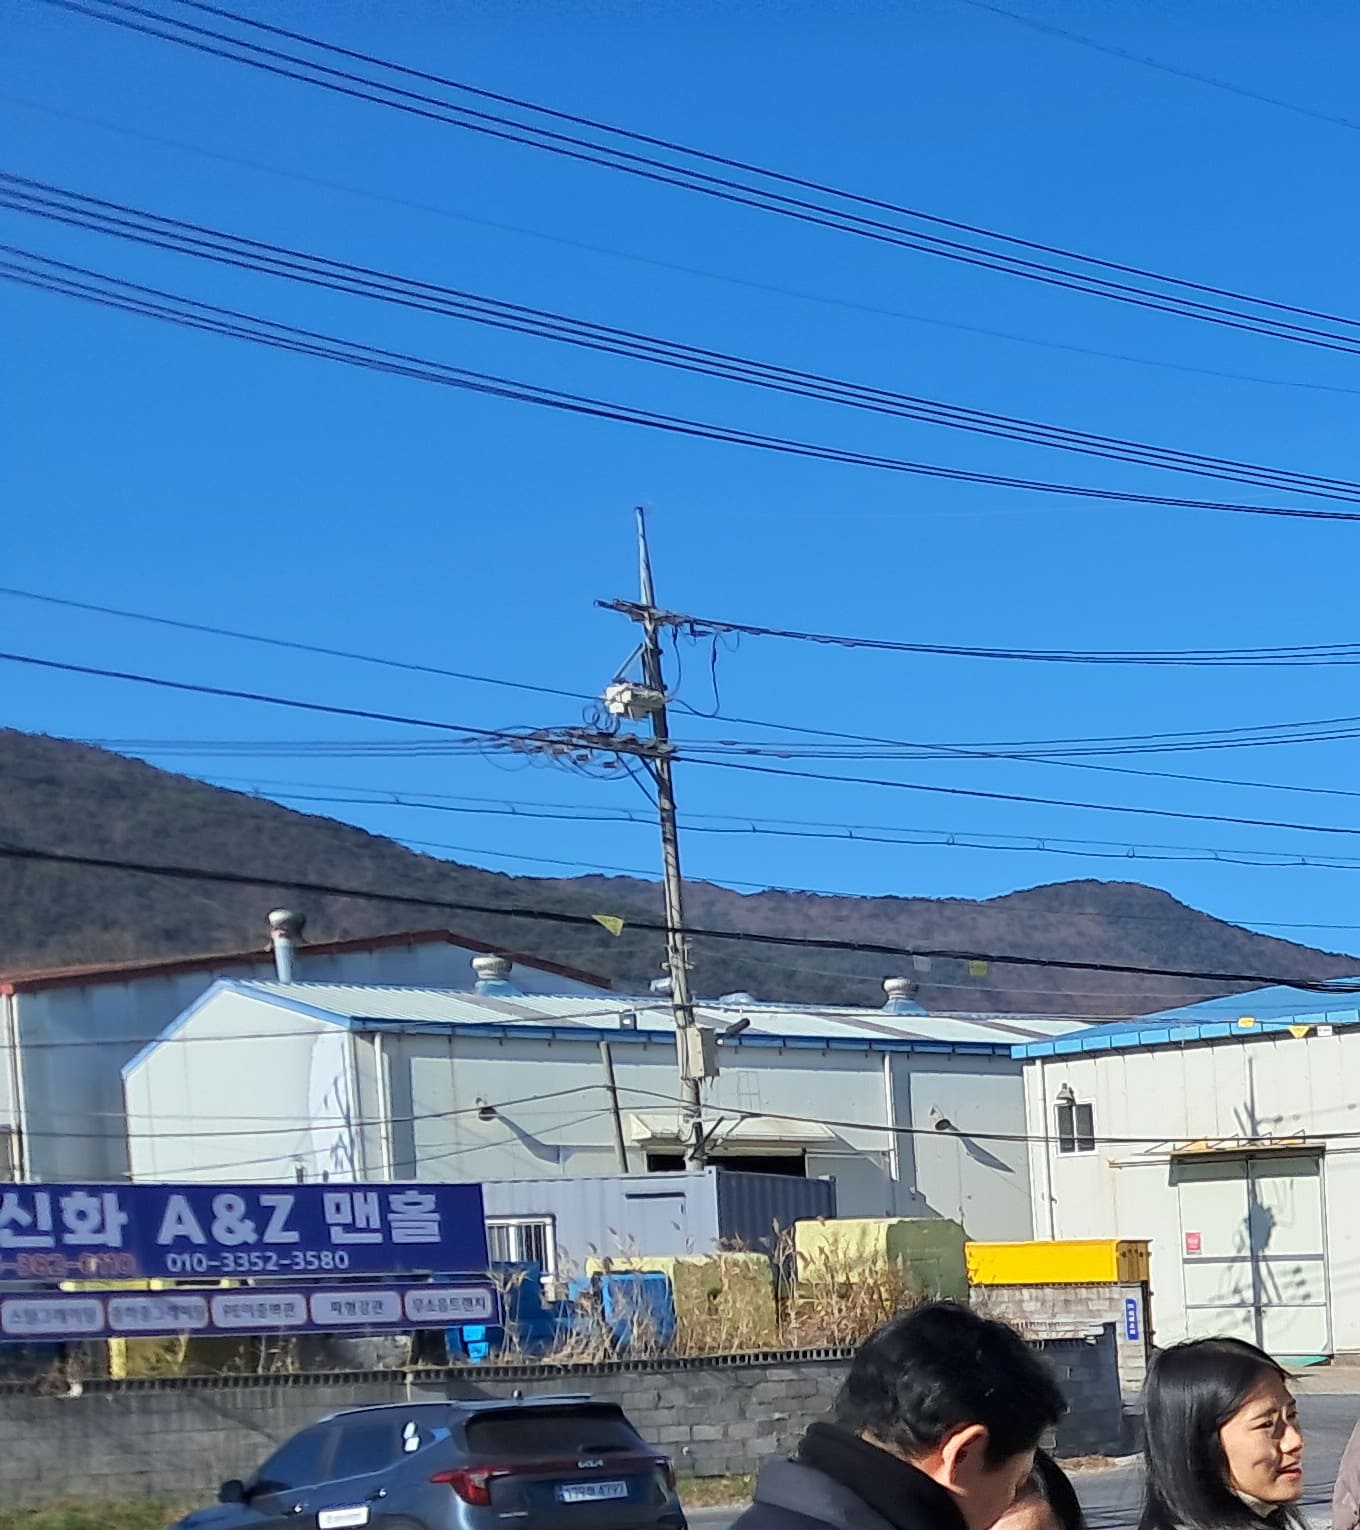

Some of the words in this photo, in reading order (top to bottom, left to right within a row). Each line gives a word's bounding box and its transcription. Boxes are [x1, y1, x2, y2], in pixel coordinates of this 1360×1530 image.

[155, 1193, 300, 1246] A&Z
[322, 1190, 442, 1245] 맨홀
[166, 1250, 349, 1273] 010-3352-3580
